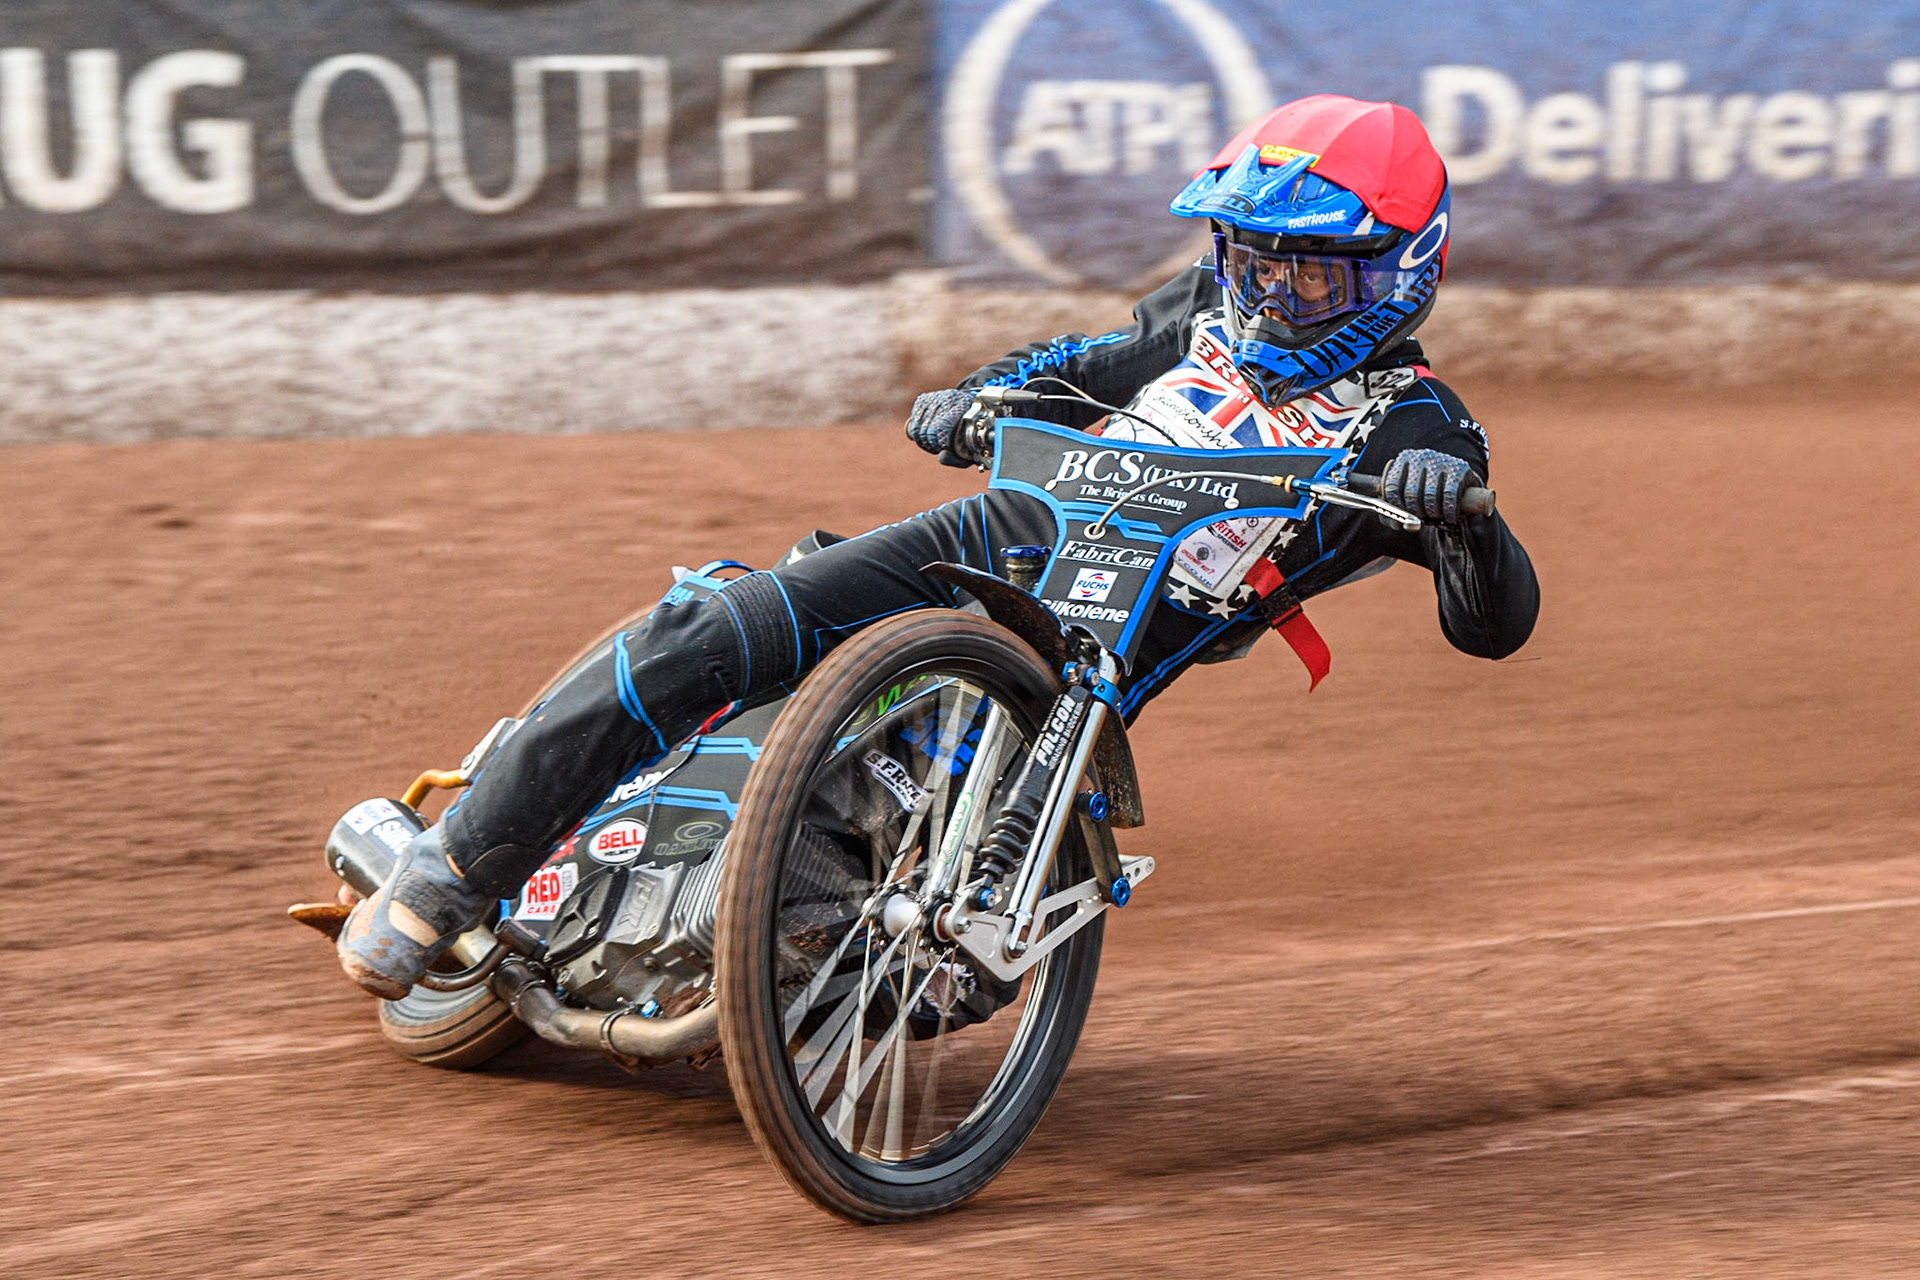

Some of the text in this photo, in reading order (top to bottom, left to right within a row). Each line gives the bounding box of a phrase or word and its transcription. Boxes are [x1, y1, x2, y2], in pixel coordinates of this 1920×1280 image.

[289, 48, 896, 214] OUTLET
[1421, 60, 1920, 186] Deliveri
[1287, 209, 1347, 230] FASTHOUSE
[1290, 324, 1378, 380] DAY
[1356, 311, 1380, 327] IN
[1193, 335, 1332, 449] BRISH
[1055, 449, 1145, 485] BCS
[1198, 476, 1239, 500] Ltd
[1079, 484, 1188, 511] The Brits Group
[1212, 520, 1248, 549] RITISH
[1057, 539, 1156, 568] FabriCan
[1075, 579, 1110, 591] FUCHS
[1036, 693, 1076, 767] FALCON
[597, 828, 644, 851] BELL
[527, 872, 560, 904] RED
[527, 904, 557, 914] CARE
